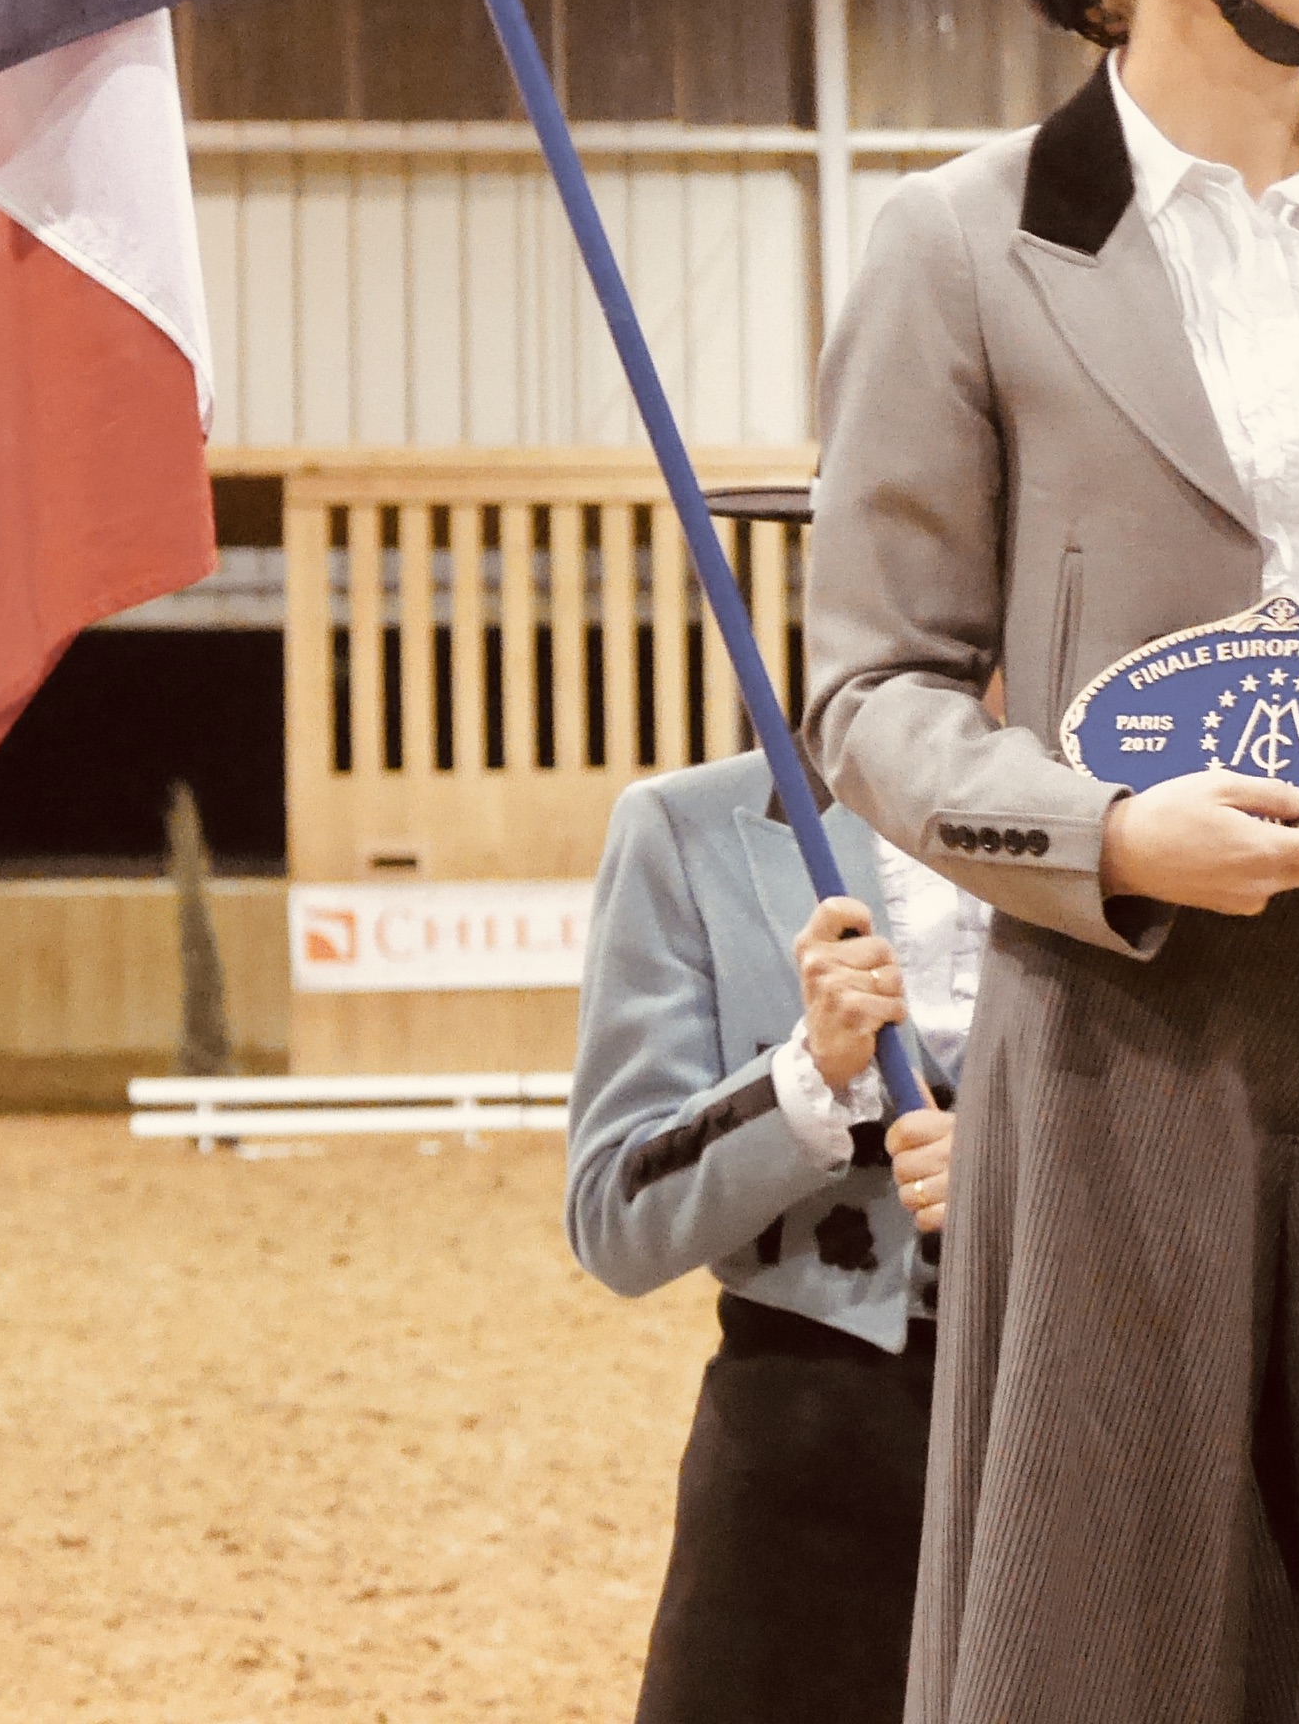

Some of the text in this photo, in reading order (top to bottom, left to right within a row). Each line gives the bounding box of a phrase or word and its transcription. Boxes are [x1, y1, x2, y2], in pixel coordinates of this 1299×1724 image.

[1127, 645, 1213, 690] FINALE
[1115, 714, 1175, 731] PARIS
[1119, 736, 1167, 753] 2017
